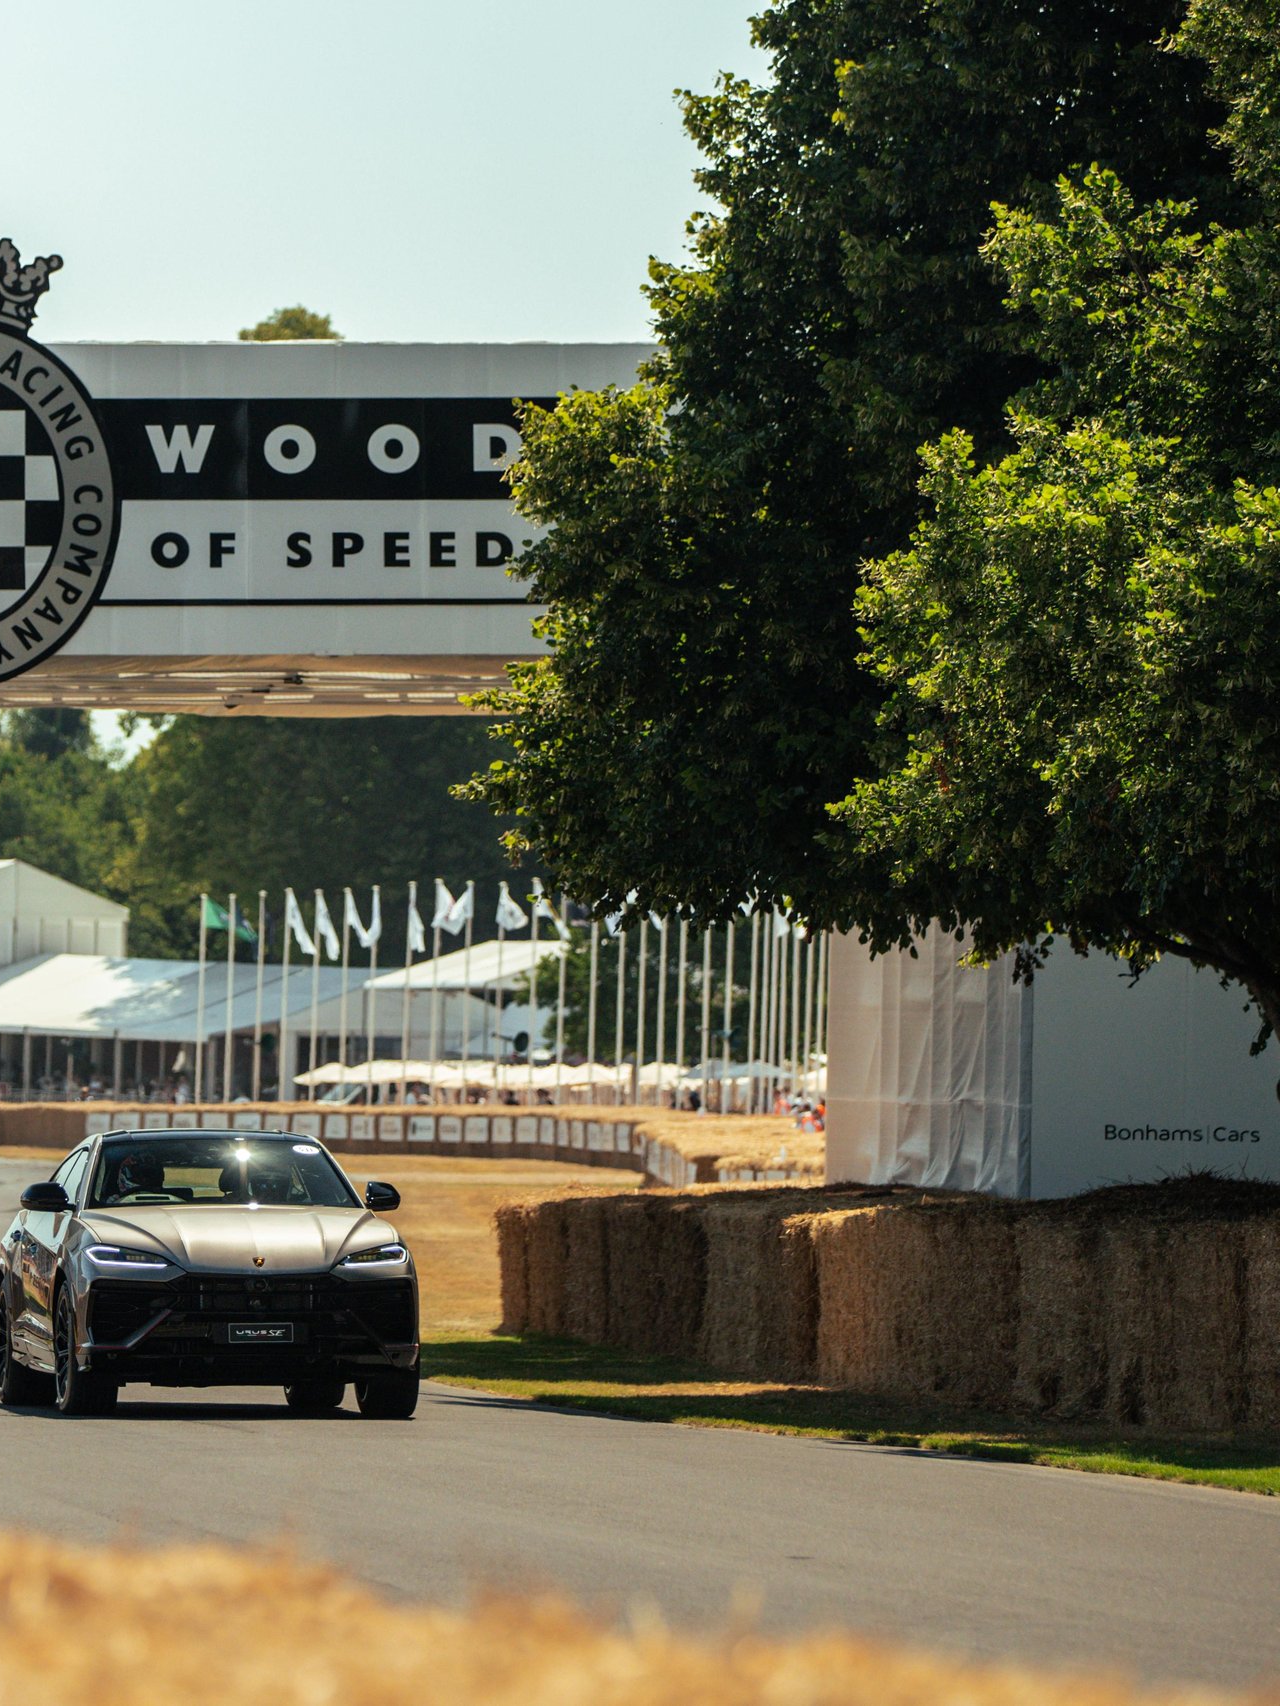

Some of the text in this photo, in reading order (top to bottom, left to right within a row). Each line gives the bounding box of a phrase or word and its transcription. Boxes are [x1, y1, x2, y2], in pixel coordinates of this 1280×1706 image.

[145, 423, 524, 474] WOOD
[150, 531, 236, 568] OF
[286, 531, 514, 568] SPEED
[1104, 1124, 1261, 1143] Bonhams Cars
